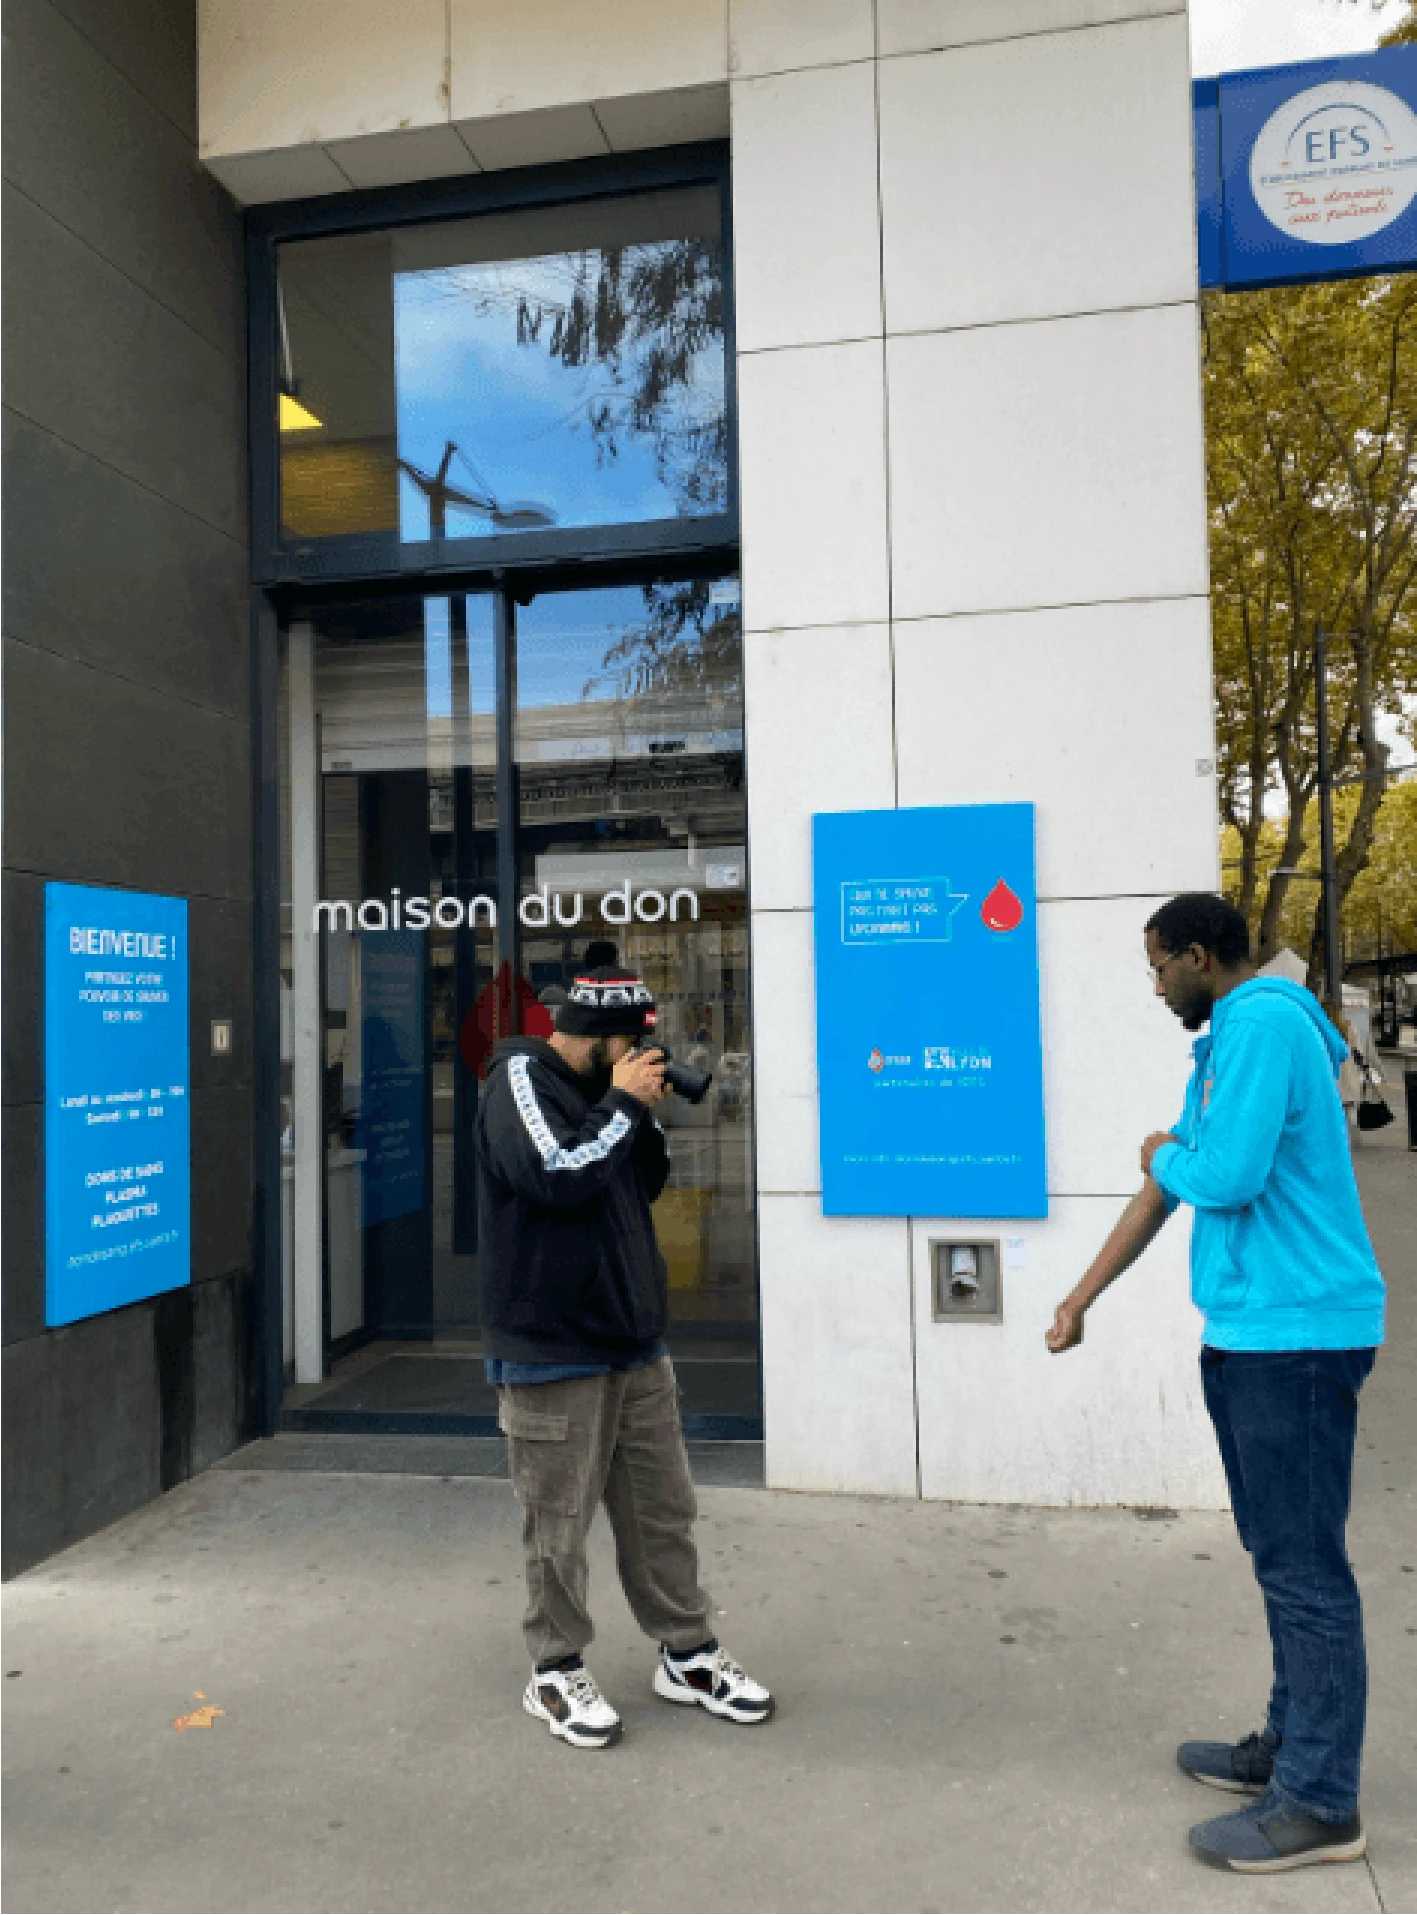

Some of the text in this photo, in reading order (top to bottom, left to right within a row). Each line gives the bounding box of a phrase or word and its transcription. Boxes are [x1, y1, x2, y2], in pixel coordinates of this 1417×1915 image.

[1306, 125, 1370, 162] EFS
[312, 879, 698, 932] maison du don
